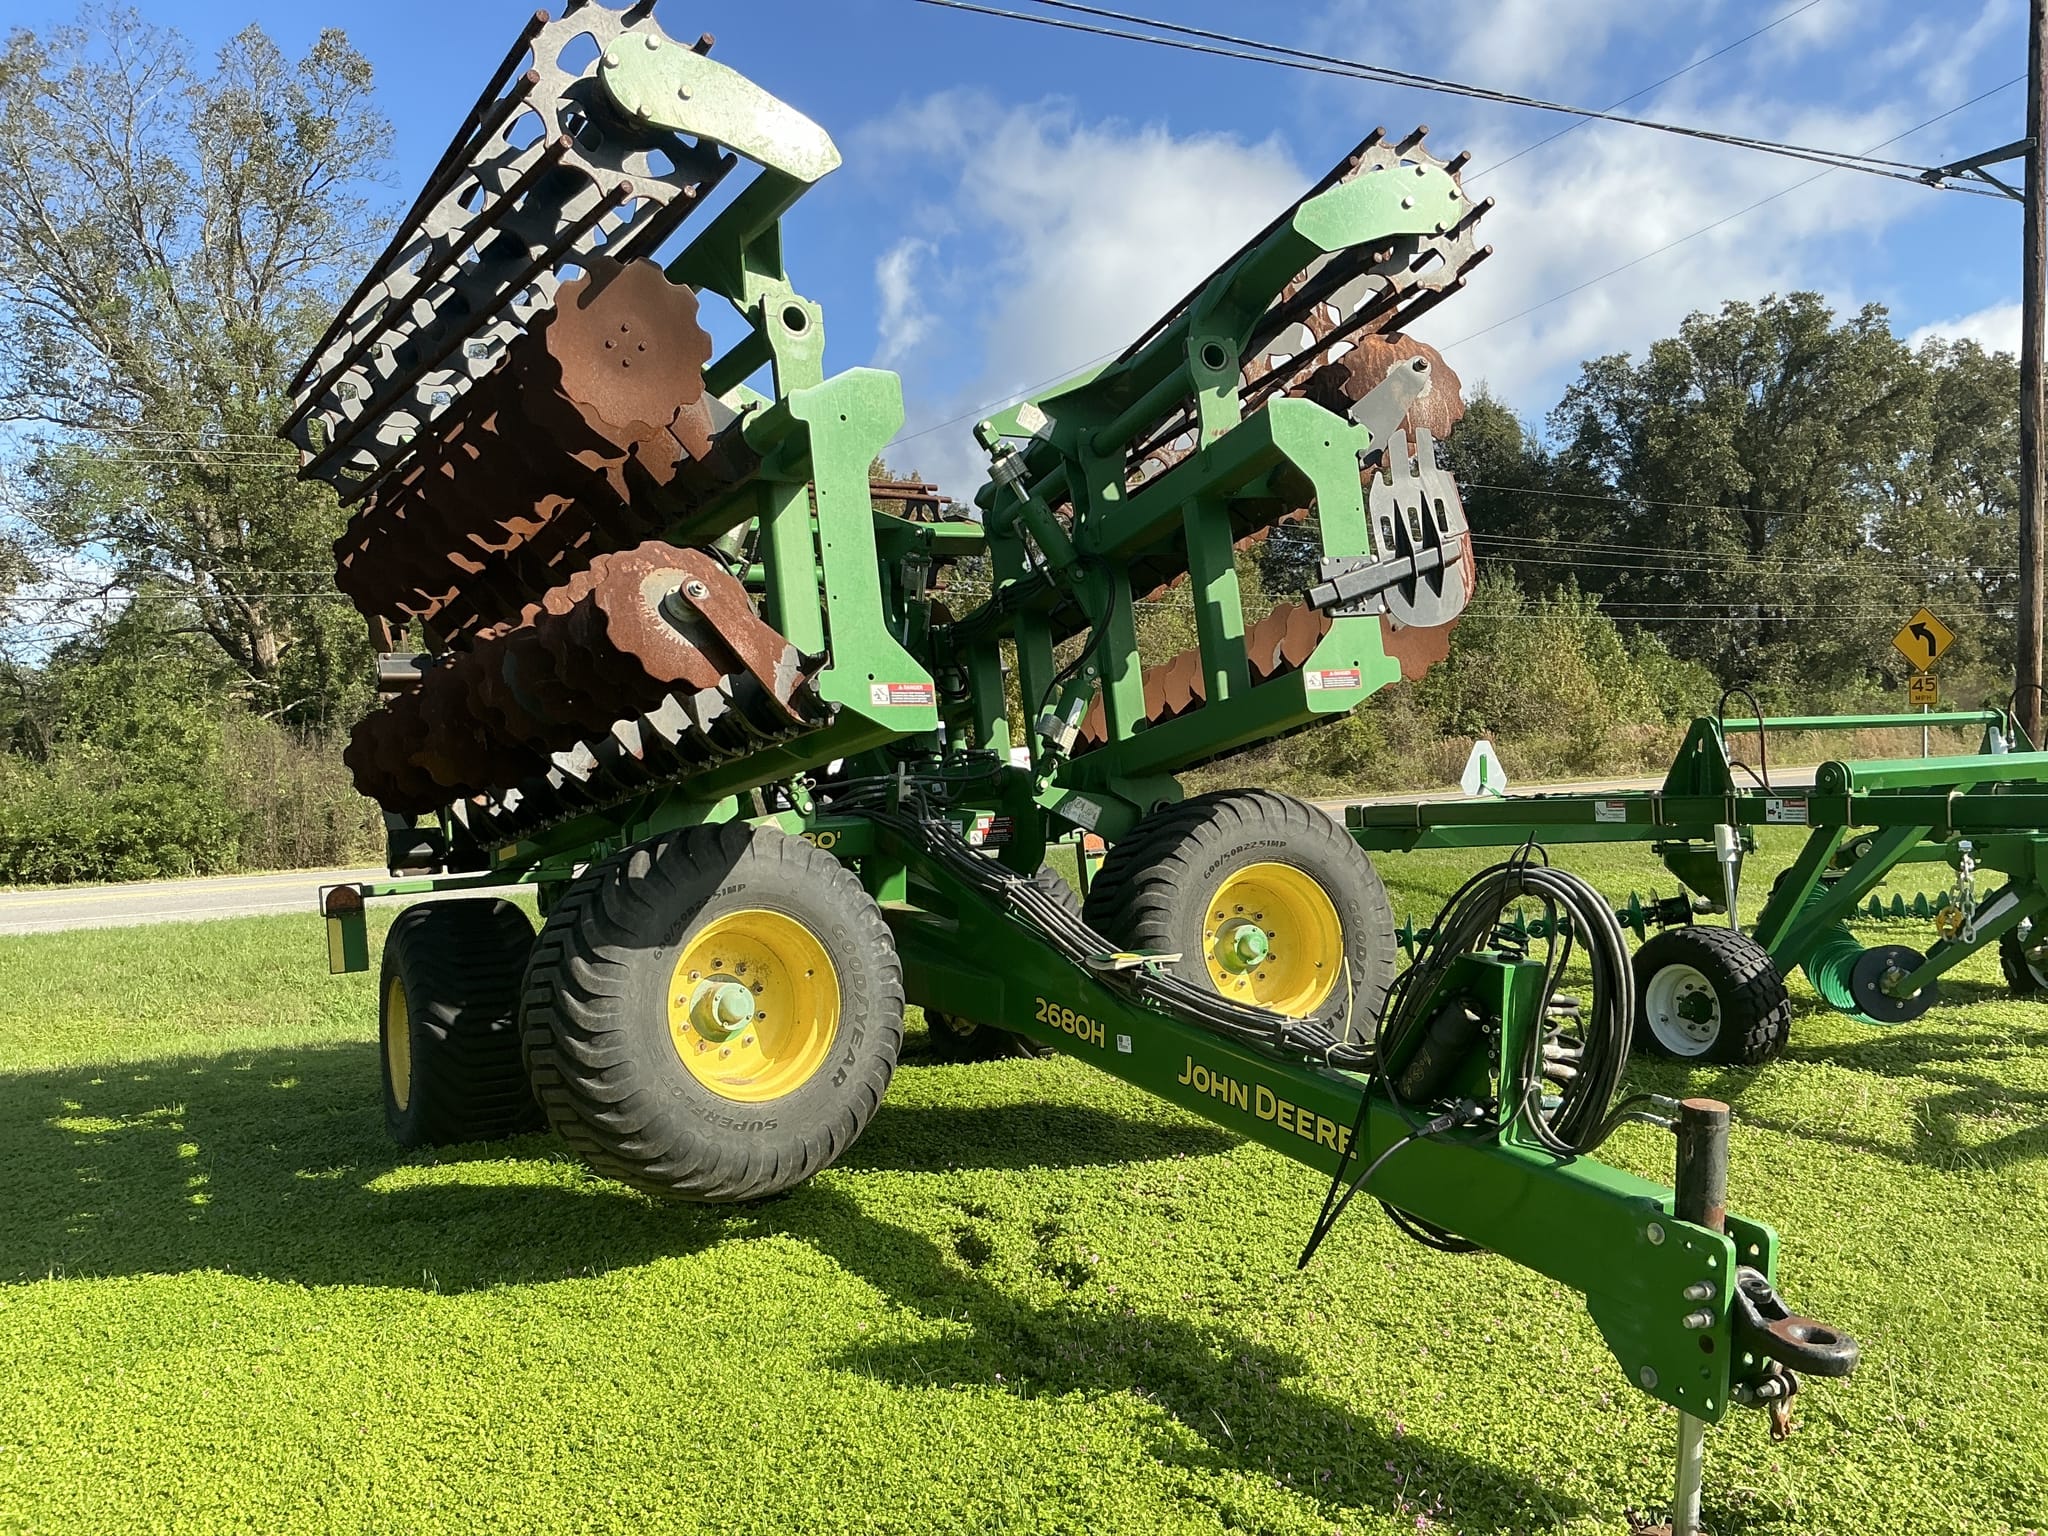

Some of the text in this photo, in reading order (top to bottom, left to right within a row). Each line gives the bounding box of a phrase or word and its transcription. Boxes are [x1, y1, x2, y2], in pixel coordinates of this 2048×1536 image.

[1912, 678, 1935, 692] 45
[831, 923, 870, 1088] GOODYEAR
[1035, 996, 1105, 1049] 2680H
[660, 1074, 778, 1132] SUPERFLOT
[1178, 1055, 1357, 1160] JOHN DEERE
